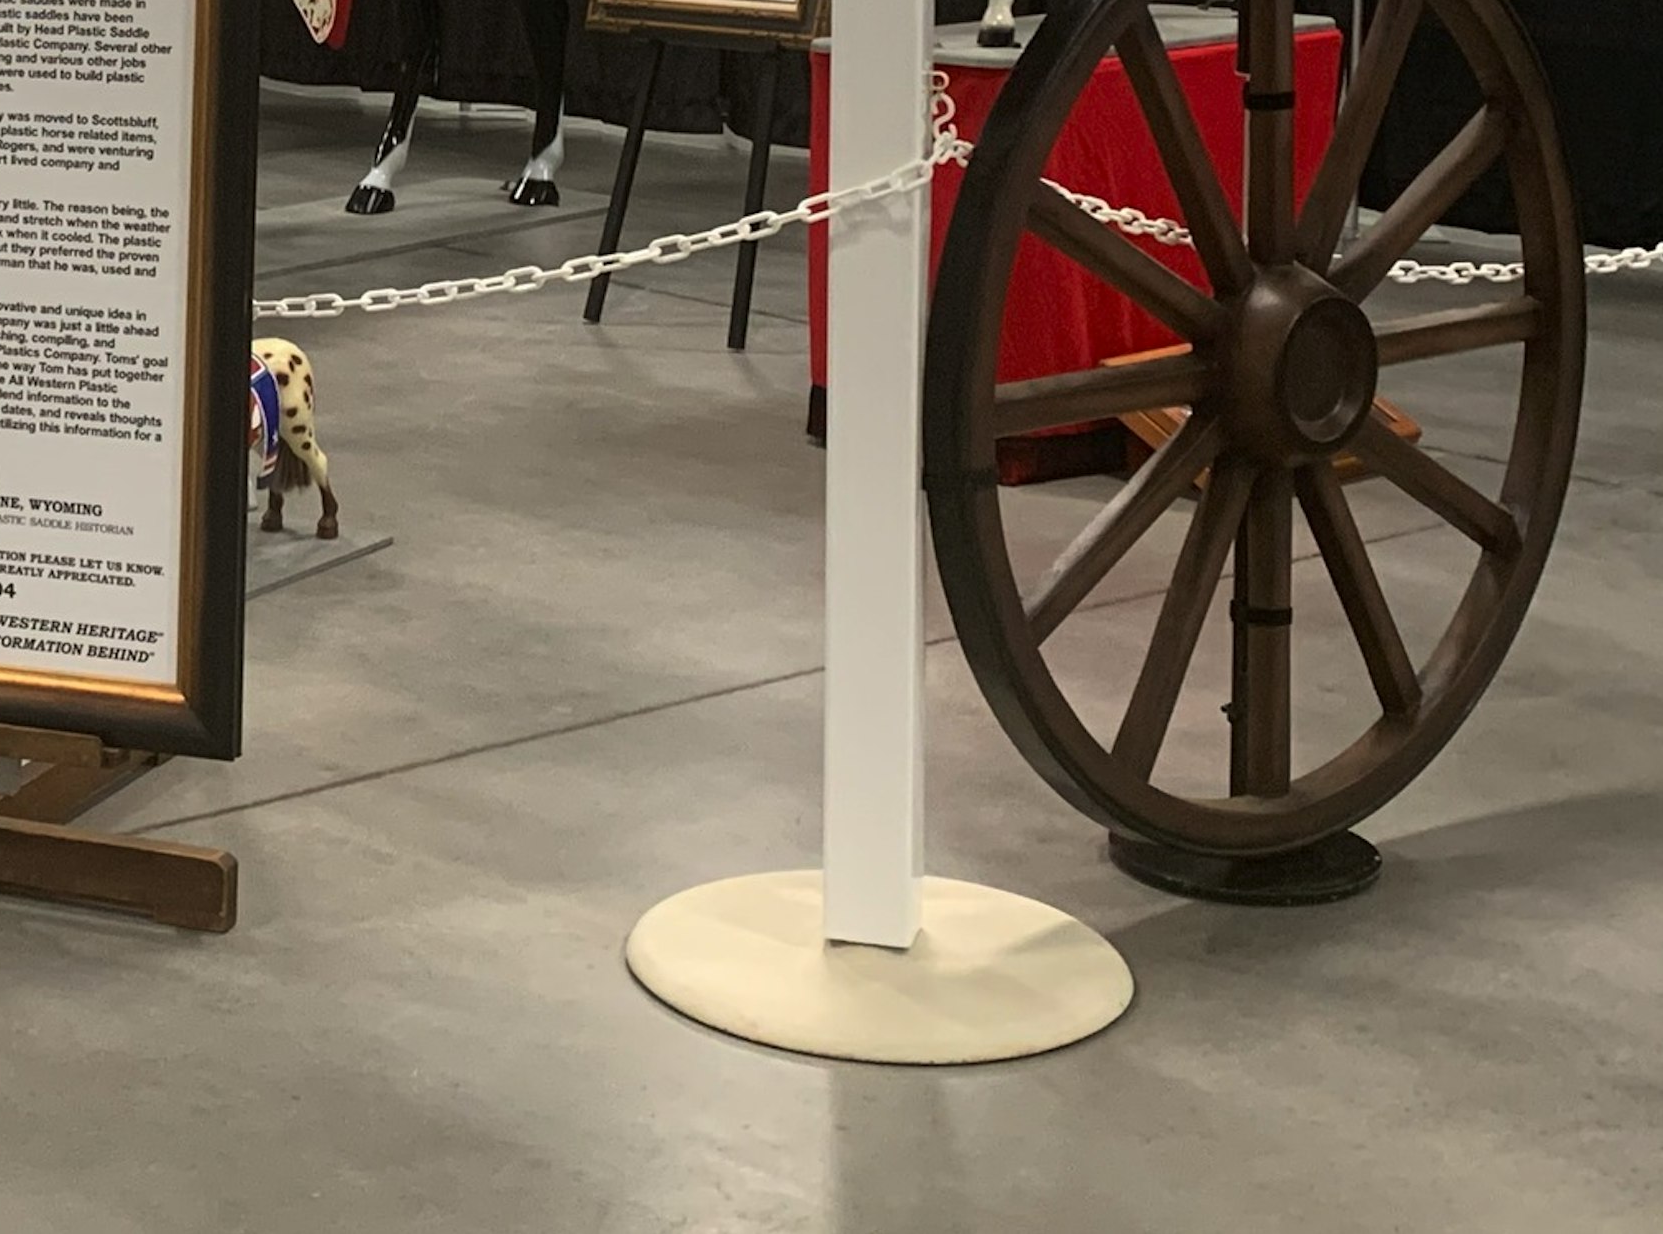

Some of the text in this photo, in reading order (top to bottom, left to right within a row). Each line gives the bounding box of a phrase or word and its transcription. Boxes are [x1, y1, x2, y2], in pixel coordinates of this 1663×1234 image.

[6, 112, 31, 122] was
[33, 112, 74, 125] moved
[75, 113, 89, 126] to
[28, 497, 103, 517] WYOMING
[29, 516, 72, 530] SADDLE
[74, 520, 134, 536] HISTORIAN
[29, 552, 76, 568] PLEASE
[78, 557, 104, 570] LET
[105, 559, 123, 572] US
[125, 562, 163, 576] KNOW.
[47, 568, 135, 587] APPRECIATED.
[75, 622, 164, 644] HERITAGE"
[85, 644, 155, 663] BEHIND"
